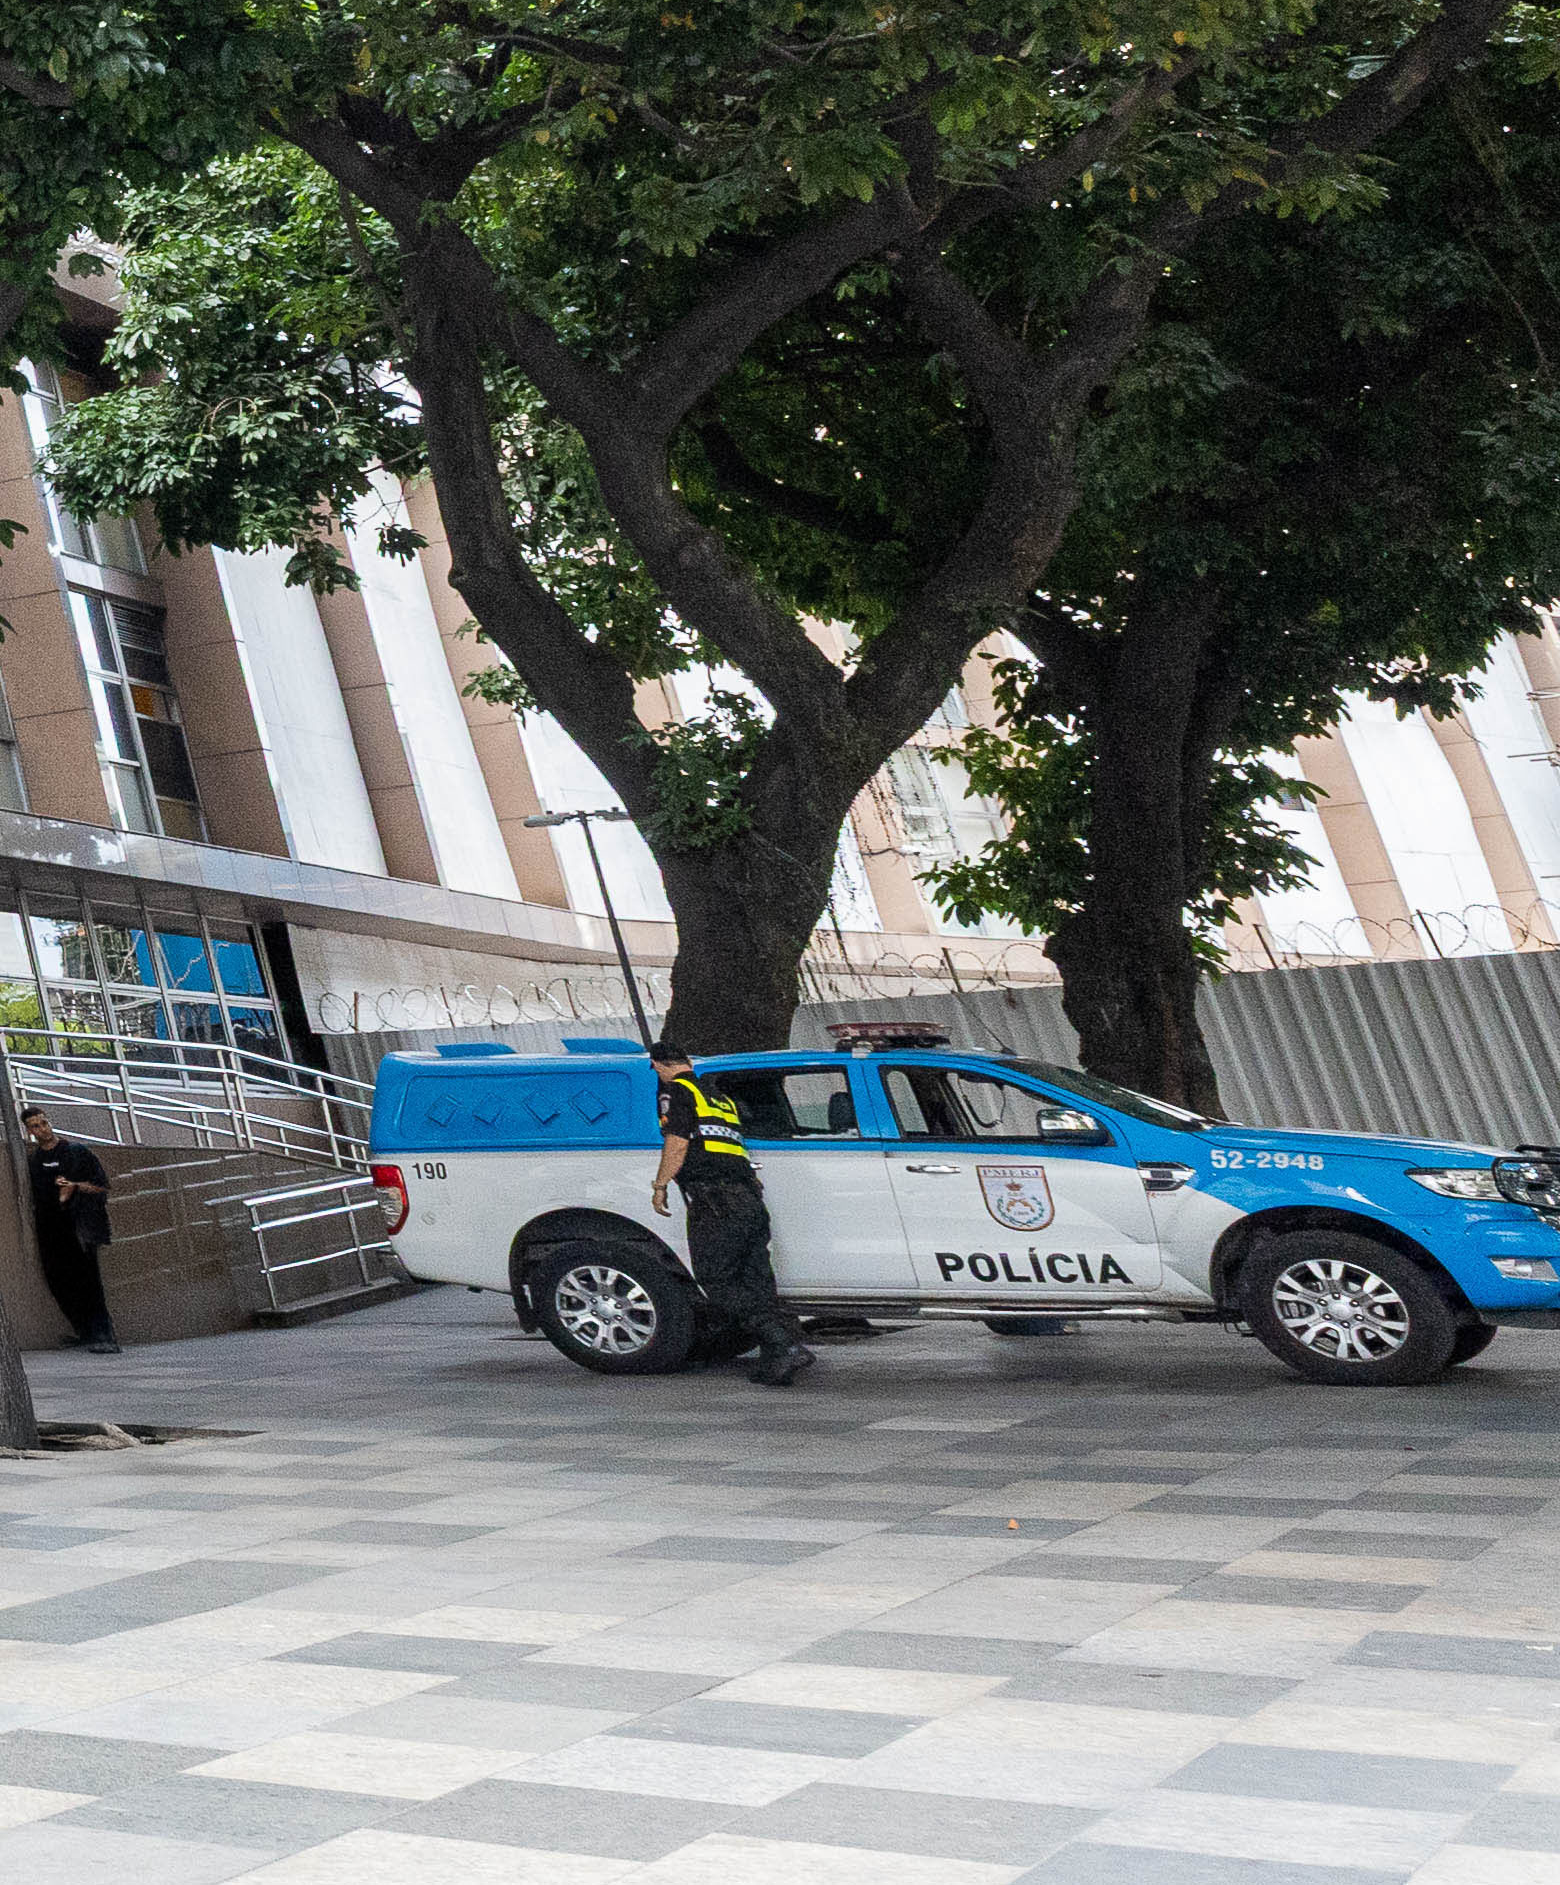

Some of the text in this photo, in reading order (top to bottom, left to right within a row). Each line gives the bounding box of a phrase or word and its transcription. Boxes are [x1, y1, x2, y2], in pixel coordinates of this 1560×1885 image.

[411, 1162, 448, 1180] 190
[1210, 1149, 1325, 1171] 52-2948
[934, 1246, 1135, 1285] POLÍCIA
